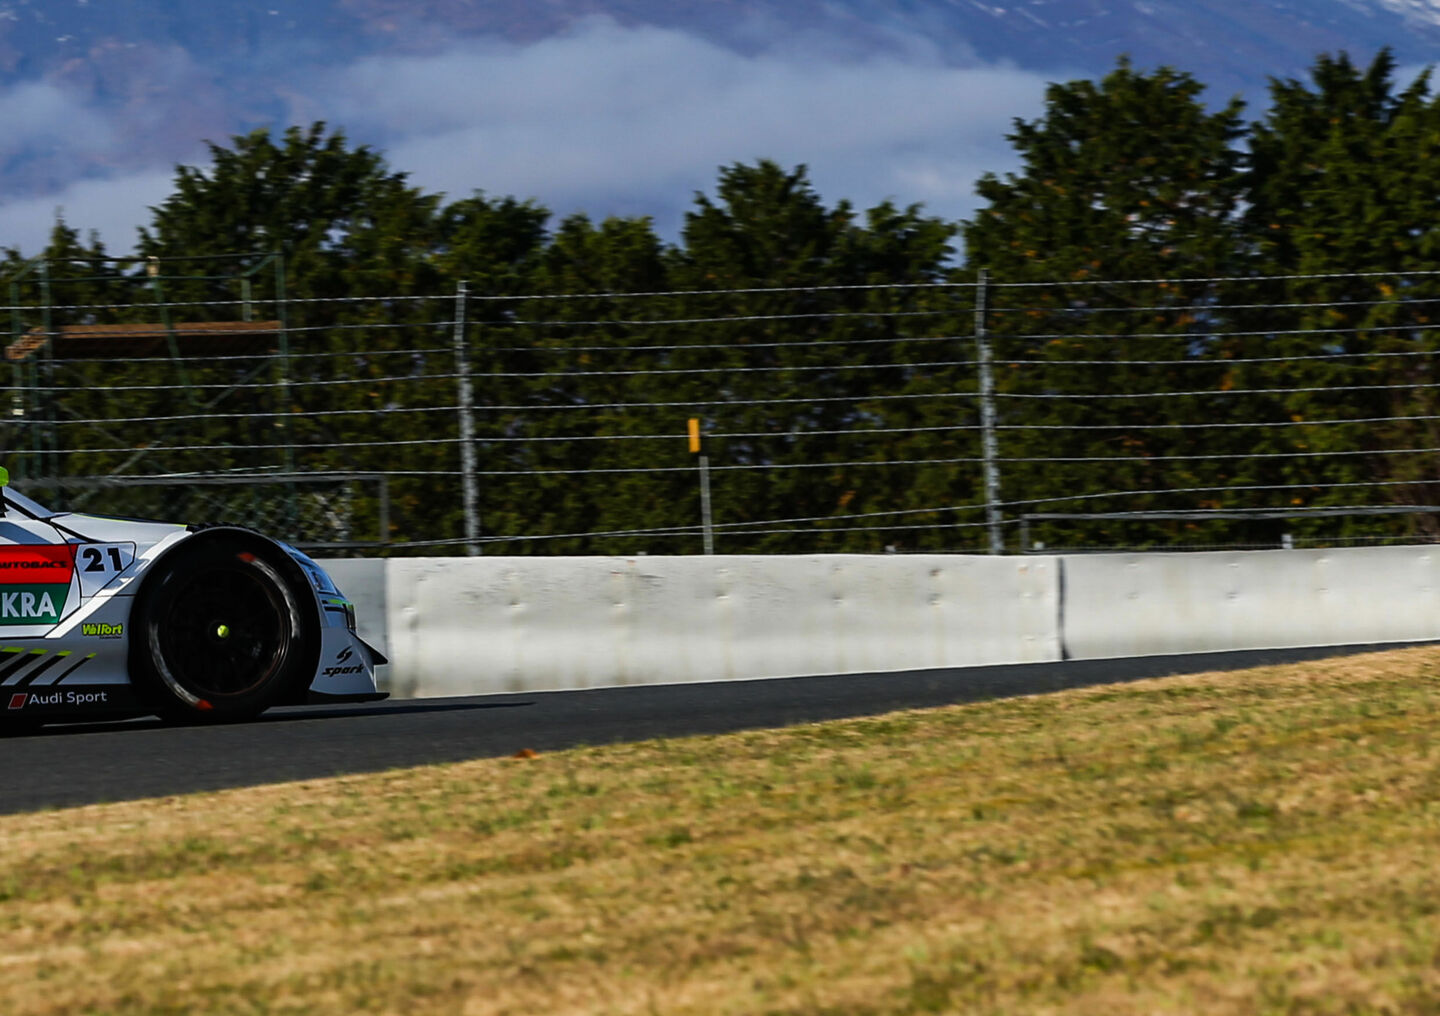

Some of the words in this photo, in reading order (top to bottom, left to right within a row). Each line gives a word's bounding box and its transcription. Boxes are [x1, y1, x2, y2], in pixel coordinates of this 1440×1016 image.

[82, 548, 123, 572] 21
[322, 663, 364, 677] spark
[29, 692, 62, 705] Audi
[66, 691, 108, 705] Sport
